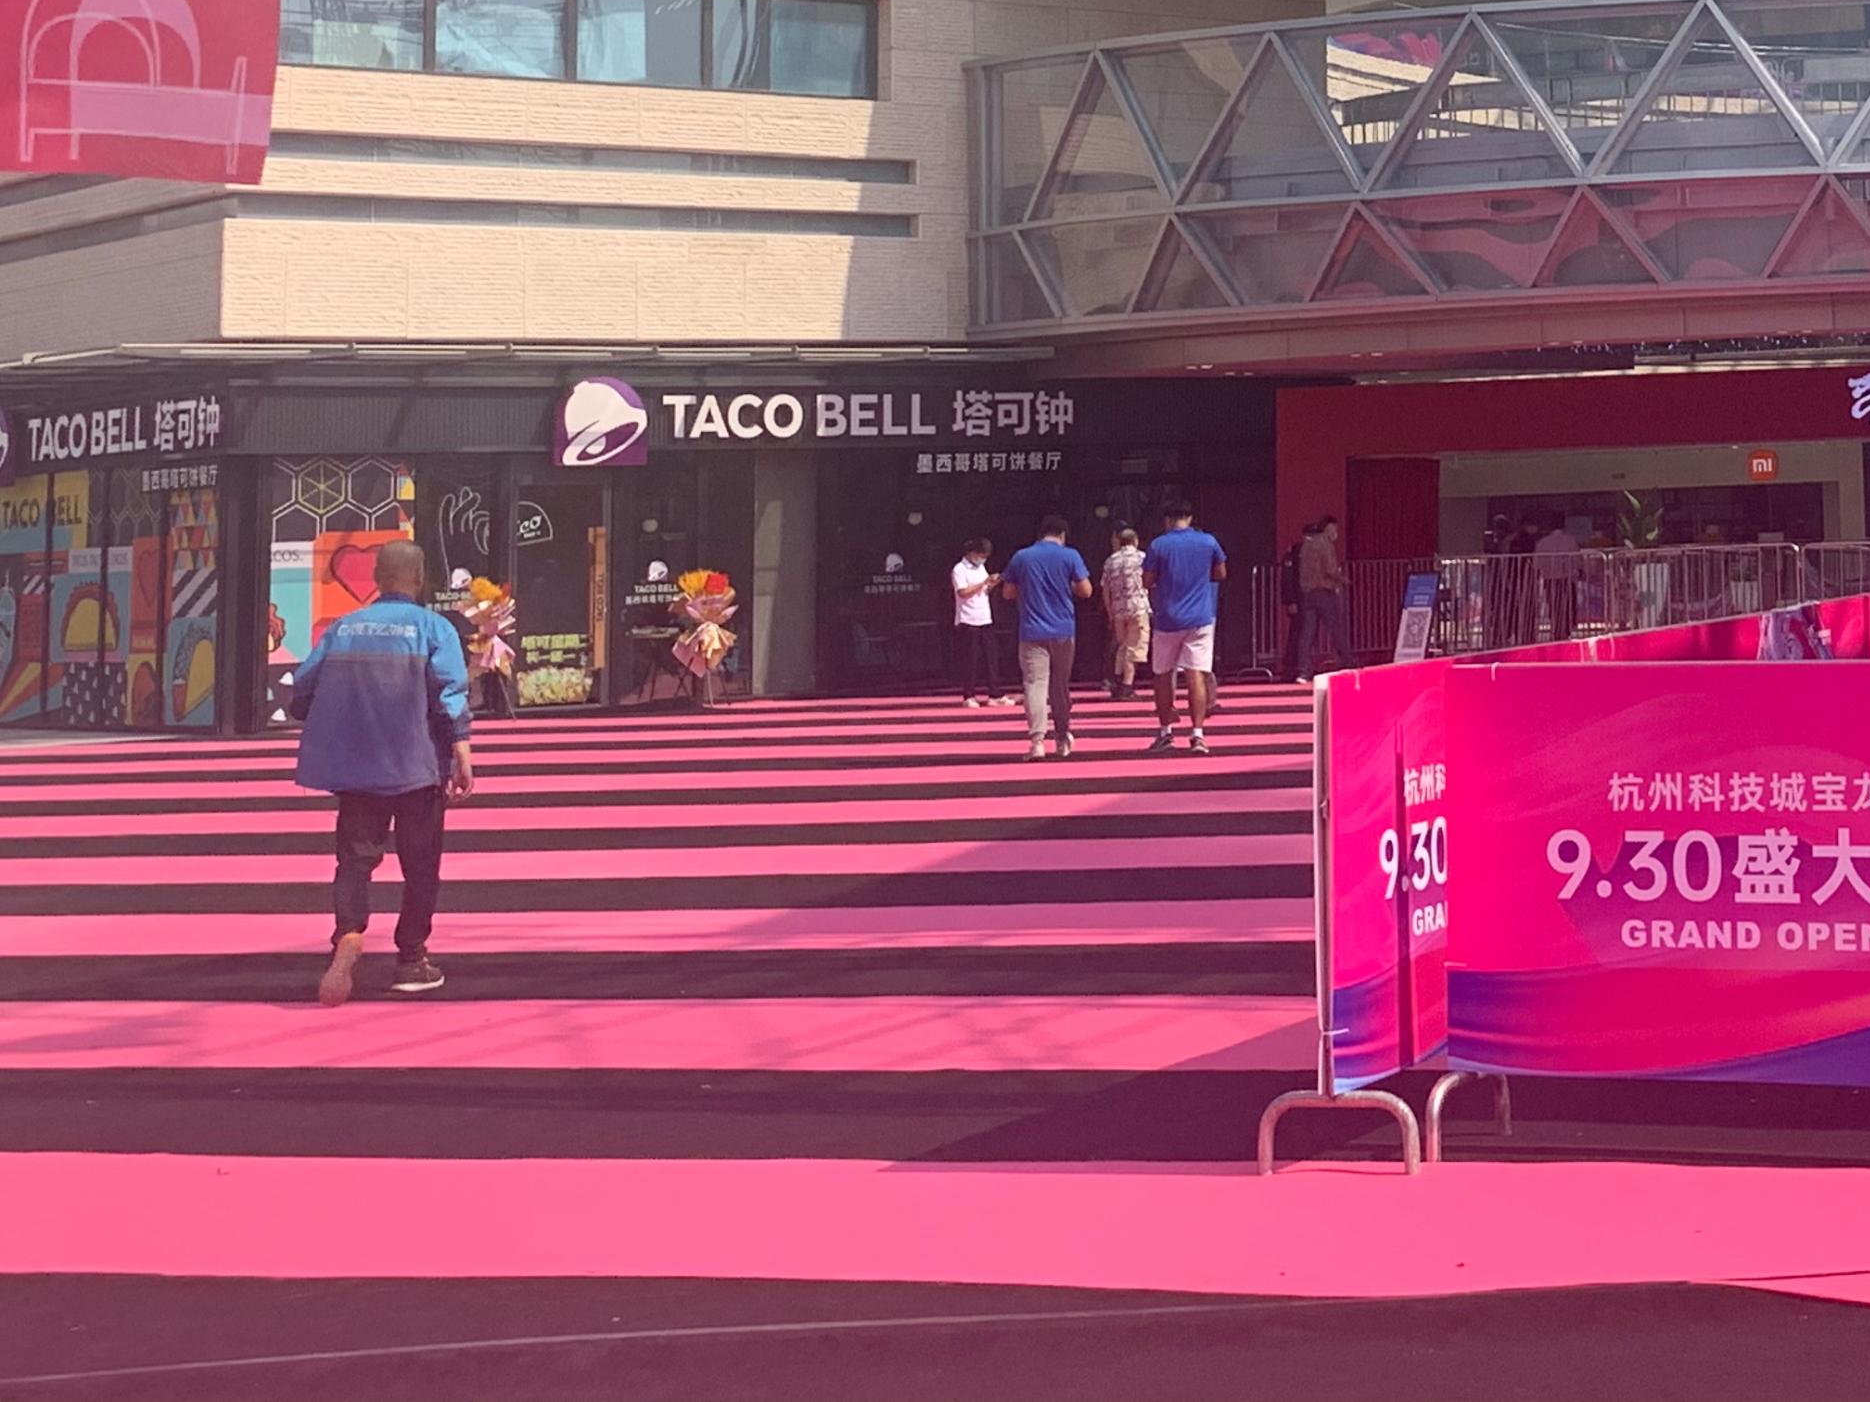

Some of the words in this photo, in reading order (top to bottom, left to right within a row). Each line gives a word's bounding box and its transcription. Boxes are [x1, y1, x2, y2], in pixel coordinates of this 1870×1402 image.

[28, 413, 87, 461] TACO
[90, 406, 147, 456] BELL
[153, 396, 220, 451] 塔可钟
[662, 394, 803, 439] TACO
[816, 394, 936, 437] BELL
[952, 390, 1074, 437] 塔可钟
[916, 451, 1062, 474] 墨西哥塔可饼餐厅
[2, 498, 40, 530] TACO
[52, 494, 82, 526] ELL
[1379, 816, 1448, 900] 9.30
[1412, 901, 1449, 936] GRA
[1620, 919, 1761, 951] GRAND
